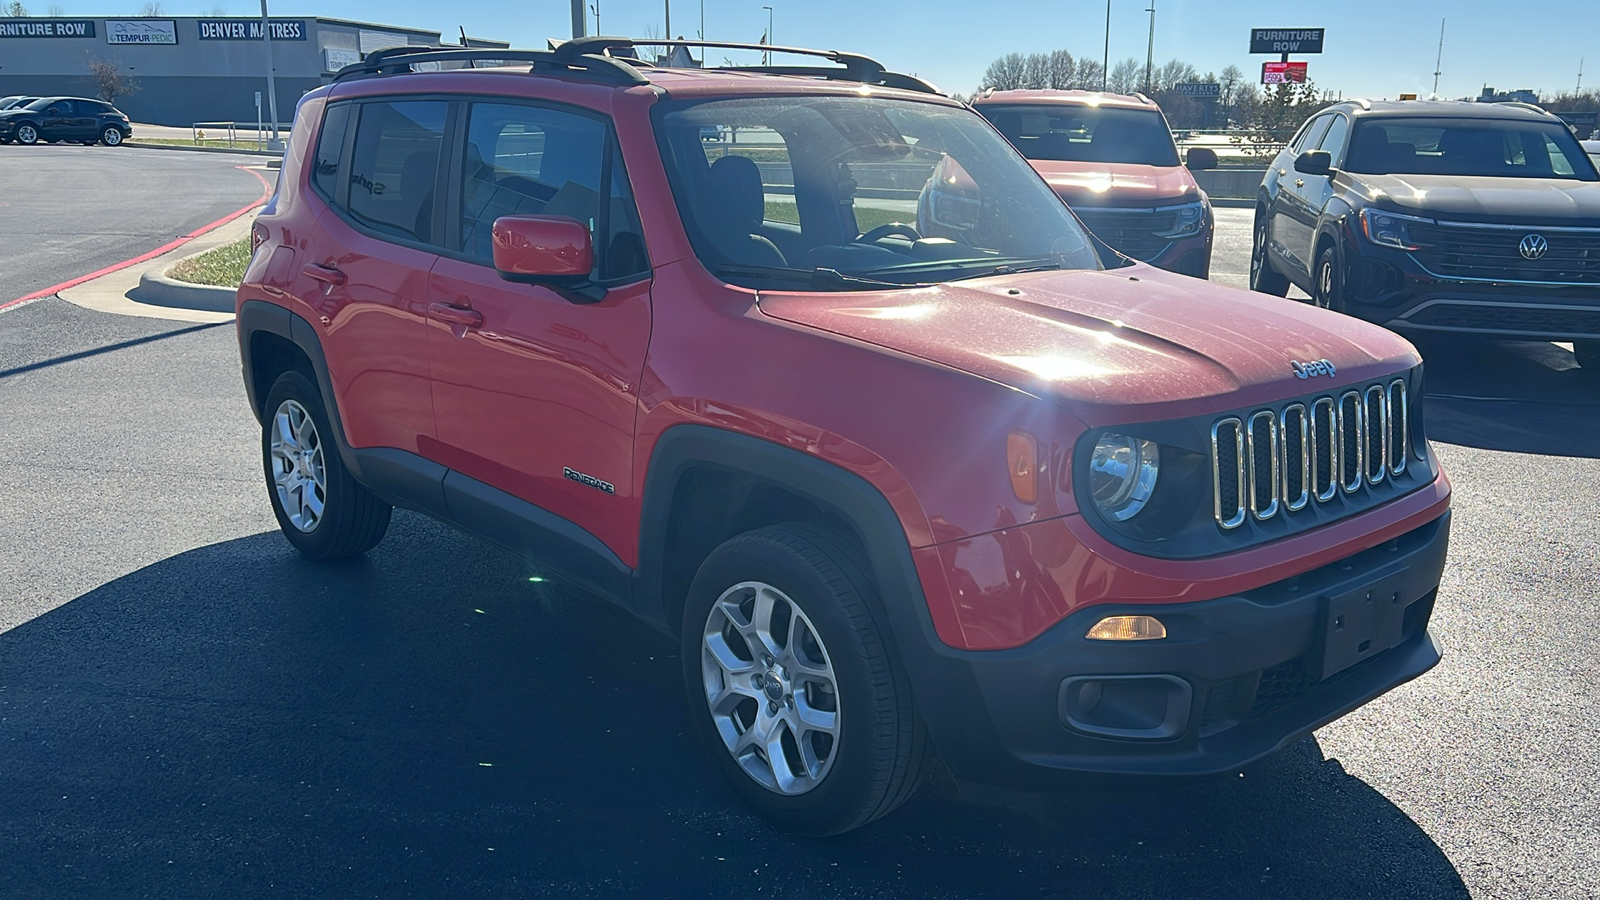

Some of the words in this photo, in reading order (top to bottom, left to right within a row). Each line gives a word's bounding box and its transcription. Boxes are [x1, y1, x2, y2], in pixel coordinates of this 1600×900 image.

[56, 23, 86, 36] ROW
[201, 22, 246, 38] DENVER
[1256, 31, 1319, 40] FURNITURE
[1273, 42, 1300, 51] ROW
[1176, 84, 1218, 92] HAVERTYS
[1290, 358, 1337, 380] Jeep
[563, 466, 615, 496] RENEGADE
